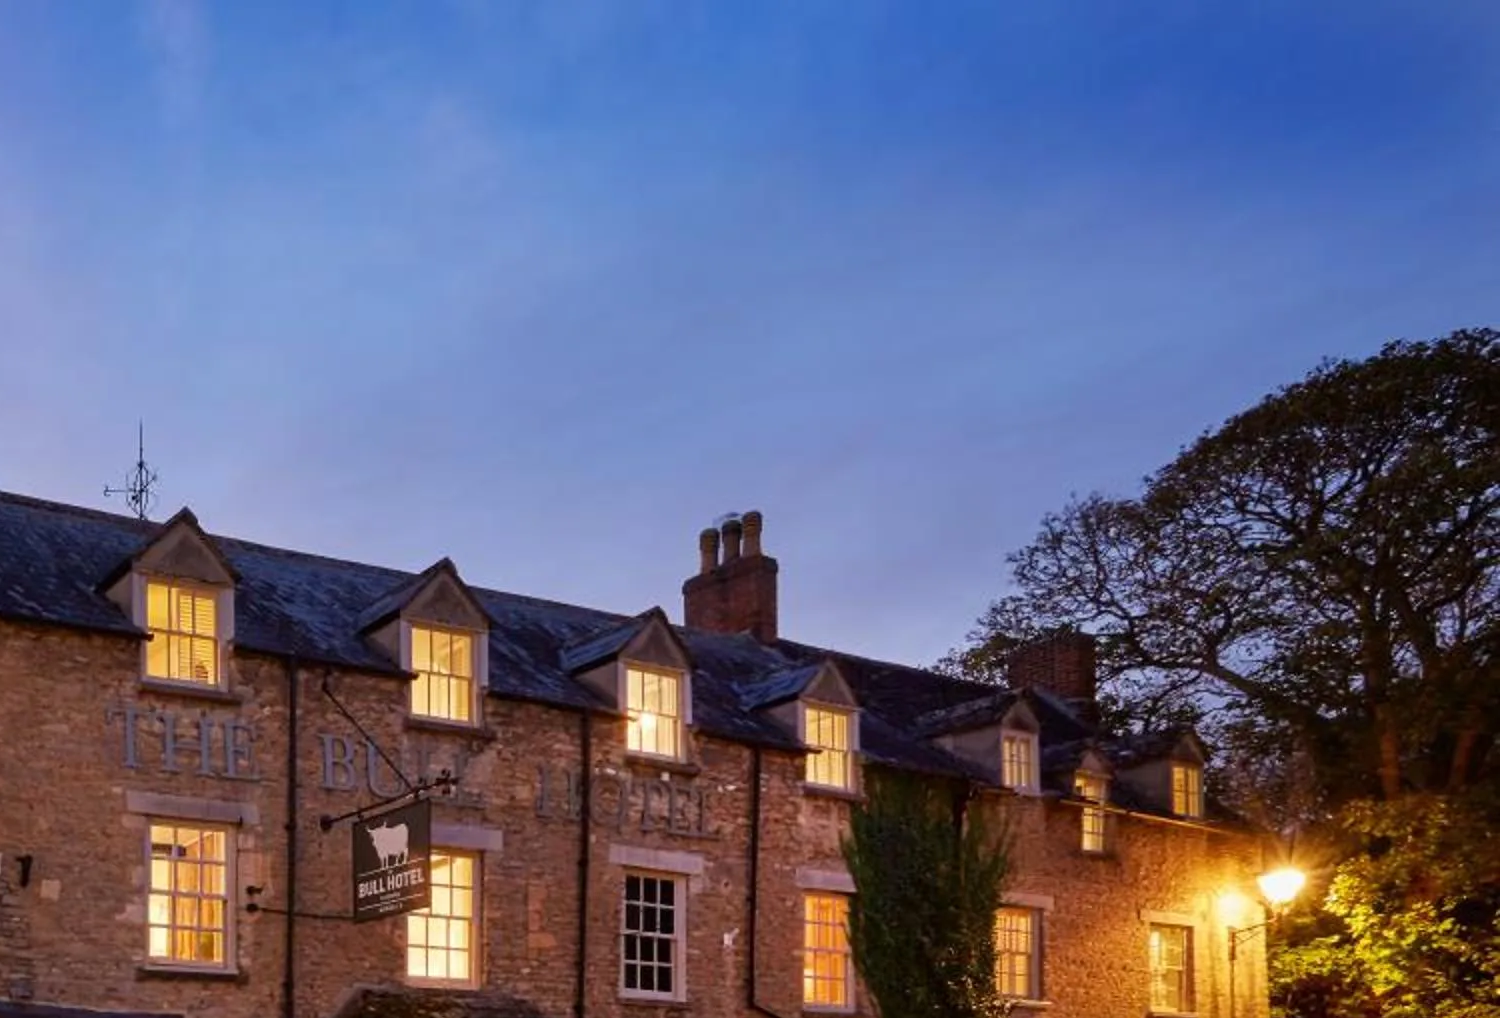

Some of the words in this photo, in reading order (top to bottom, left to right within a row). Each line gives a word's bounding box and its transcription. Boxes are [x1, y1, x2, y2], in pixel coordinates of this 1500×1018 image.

[106, 704, 261, 779] THE
[358, 878, 385, 898] BULL
[387, 868, 424, 890] HOTEL
